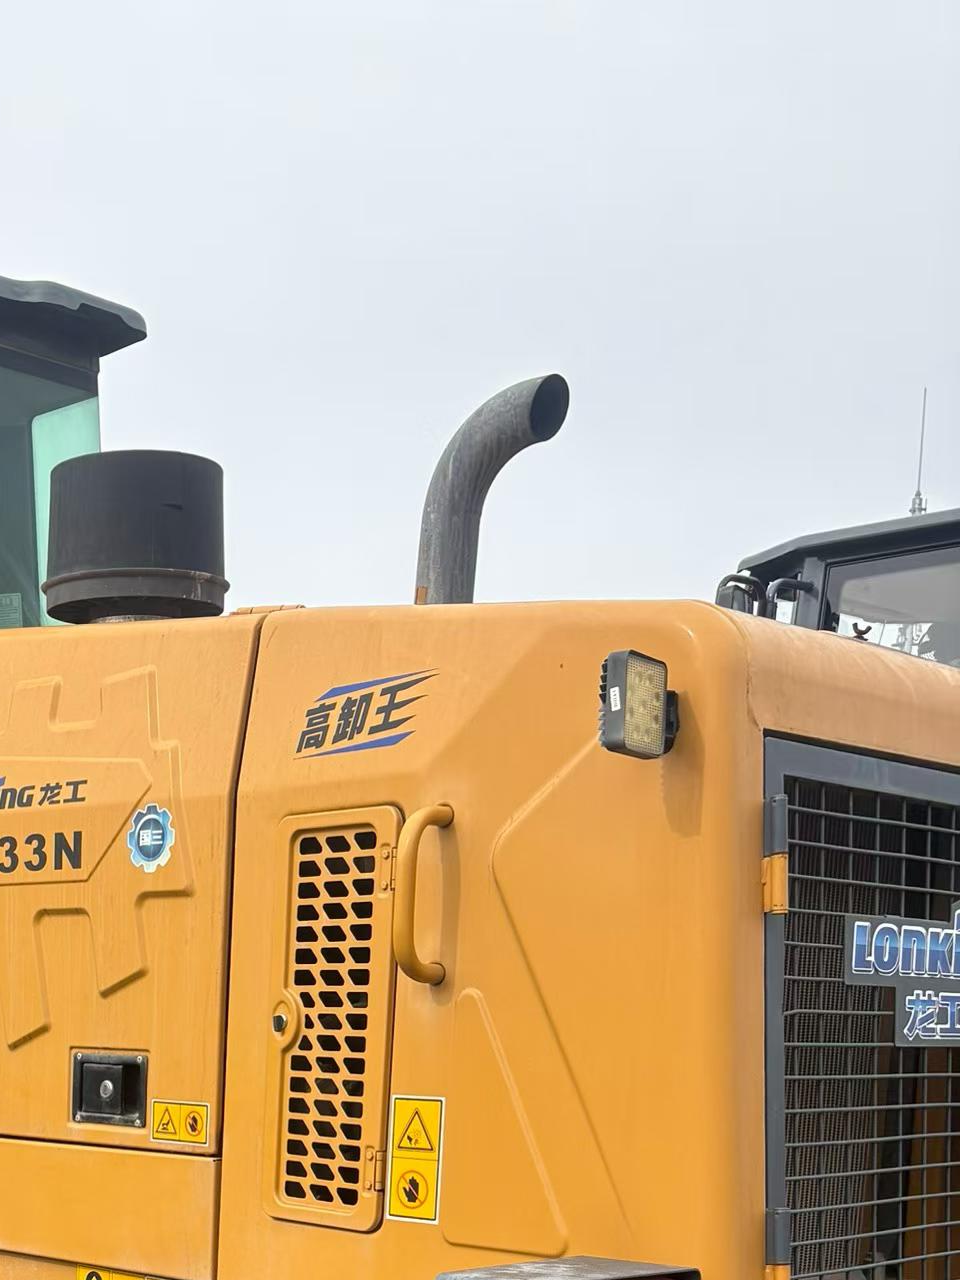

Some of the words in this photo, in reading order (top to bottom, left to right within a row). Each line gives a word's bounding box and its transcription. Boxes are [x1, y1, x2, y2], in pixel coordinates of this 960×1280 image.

[296, 673, 440, 753] 高卸王
[38, 779, 88, 806] 龙工
[139, 829, 163, 847] 国三
